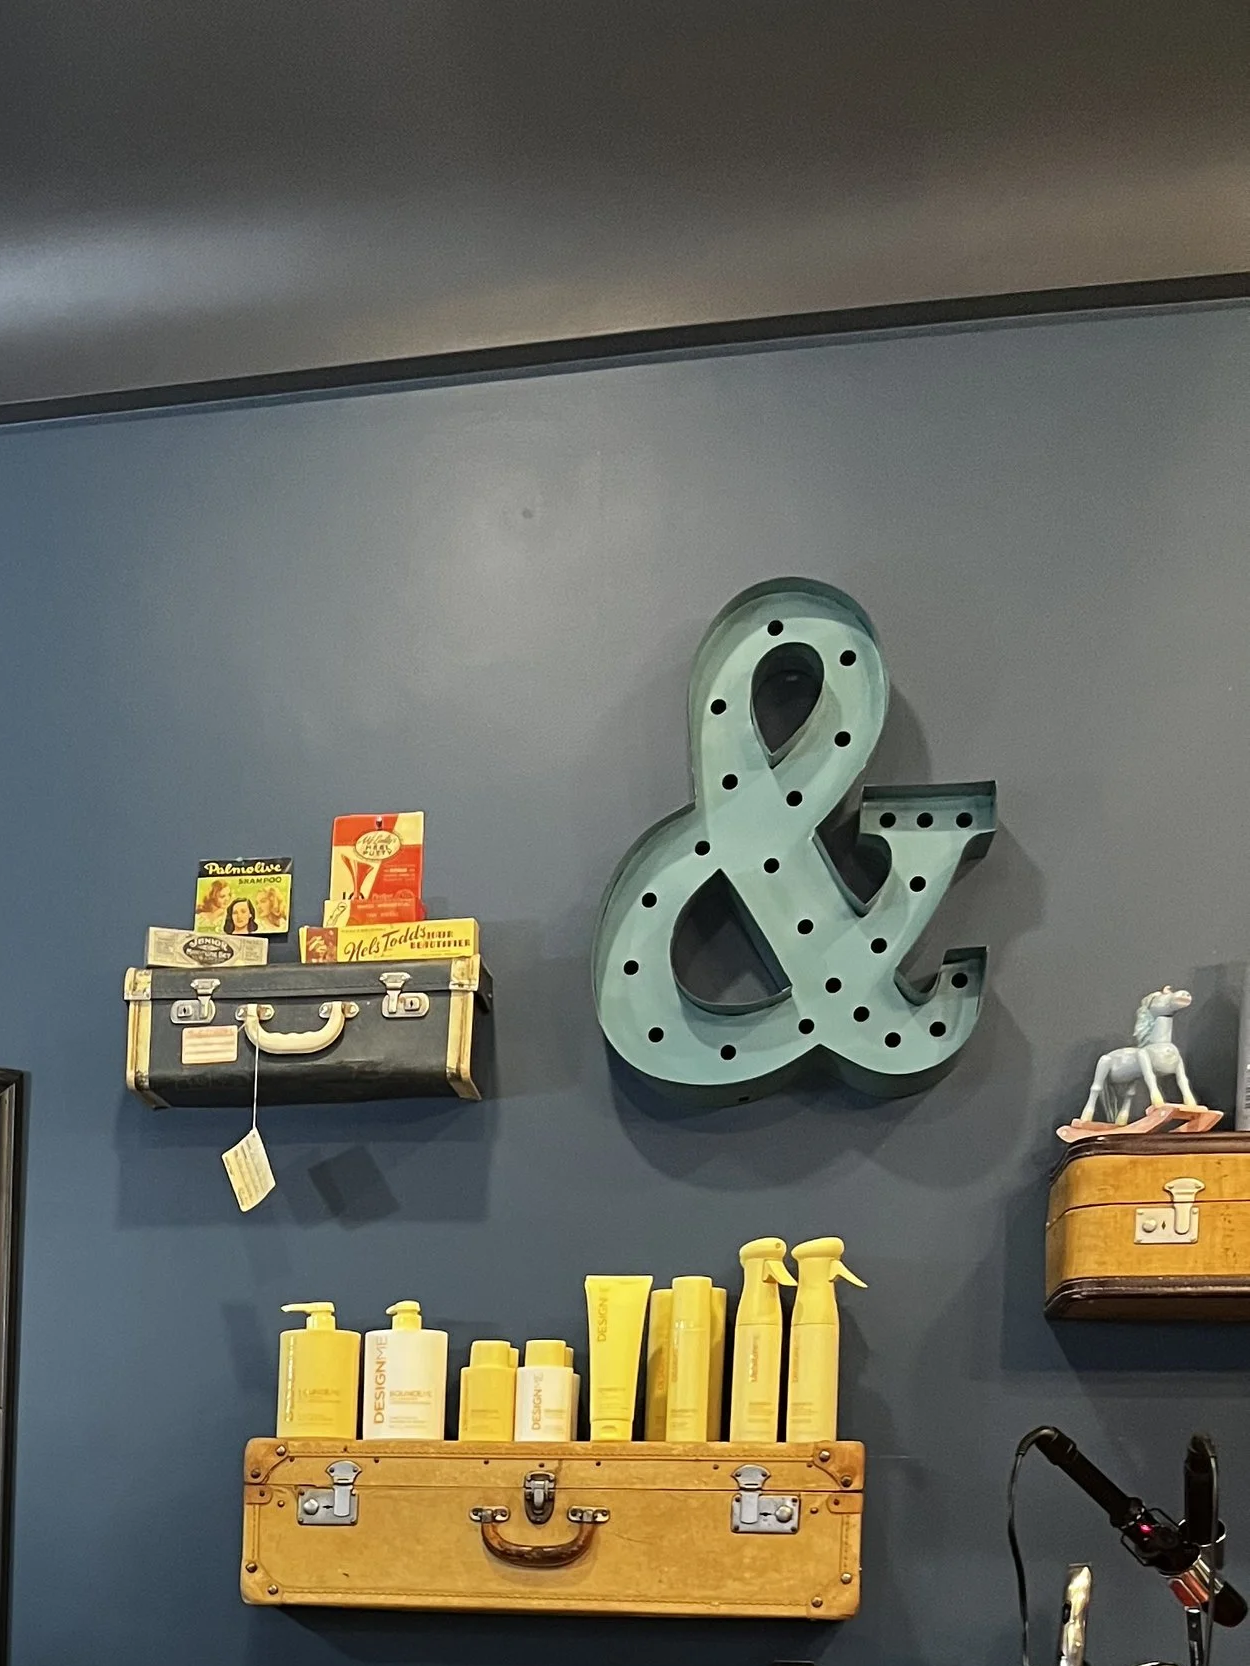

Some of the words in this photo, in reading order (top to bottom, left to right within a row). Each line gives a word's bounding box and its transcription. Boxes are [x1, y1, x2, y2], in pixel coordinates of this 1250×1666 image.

[592, 577, 997, 1107] &
[204, 861, 283, 875] Palmolive
[238, 876, 282, 885] SHAMPOO
[188, 937, 228, 951] JUNIOR
[373, 1335, 388, 1425] DESIGNME
